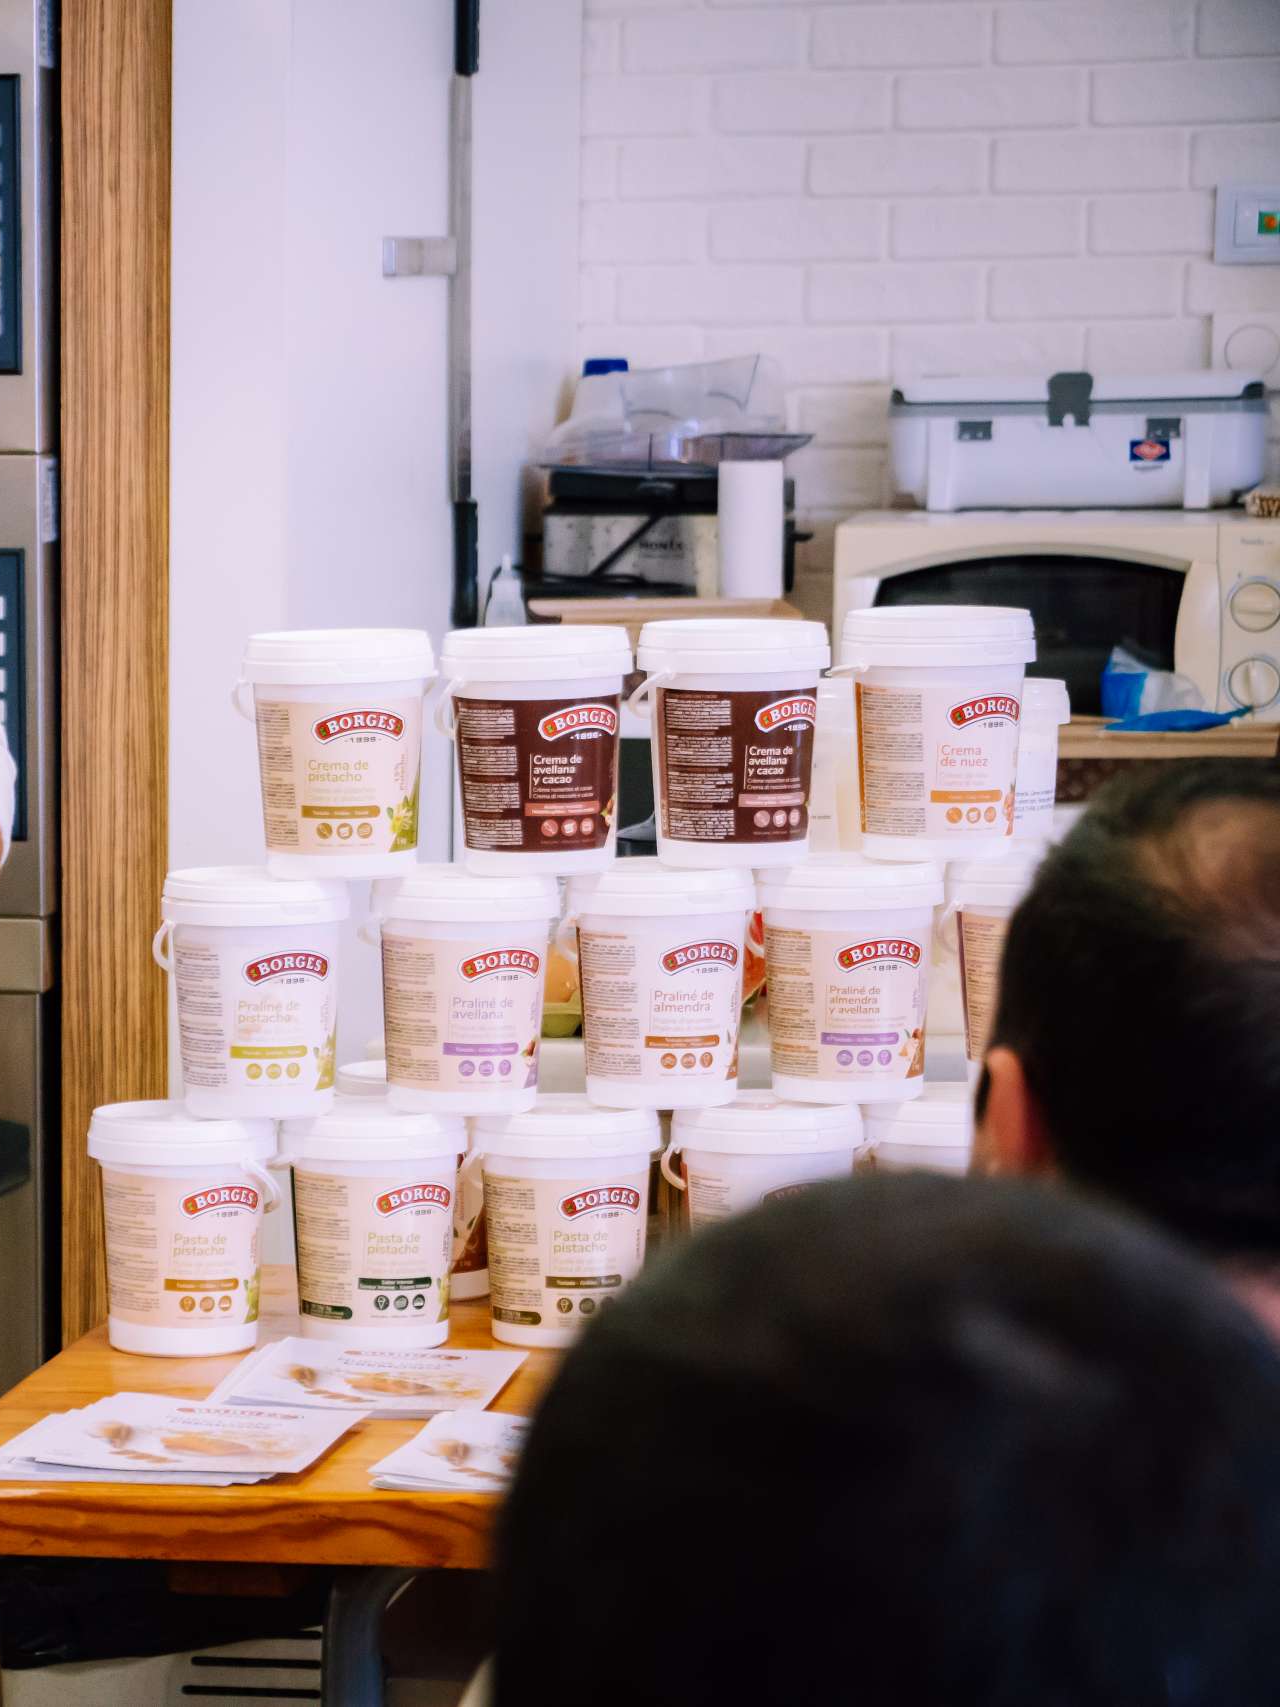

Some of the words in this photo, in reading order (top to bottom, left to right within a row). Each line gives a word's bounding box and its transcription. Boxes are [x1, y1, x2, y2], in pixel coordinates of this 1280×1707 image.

[963, 699, 1017, 719] BORGES
[326, 714, 396, 734] BORGES
[553, 710, 613, 731] BORGES
[749, 746, 781, 756] Crema
[782, 745, 794, 755] de
[941, 744, 982, 756] Crema
[308, 759, 350, 771] Crema
[353, 759, 369, 771] de
[533, 755, 568, 765] Crema
[570, 754, 583, 764] de
[749, 756, 788, 766] avellana
[940, 757, 957, 767] de
[960, 758, 989, 767] nuez
[533, 765, 577, 775] avellana
[748, 767, 755, 776] y
[756, 766, 785, 775] cacao
[308, 772, 362, 784] pistacho
[533, 776, 540, 786] y
[542, 775, 573, 784] cacao
[674, 945, 734, 965] BORGES
[849, 943, 916, 962] BORGES
[257, 955, 323, 976] BORGES
[473, 952, 536, 972] BORGES
[654, 990, 698, 1001] Praliné
[703, 990, 715, 1000] de
[829, 985, 866, 995] Praliné
[868, 986, 881, 995] de
[287, 1000, 300, 1011] de
[452, 997, 496, 1009] Praliné
[500, 998, 514, 1008] de
[829, 996, 879, 1005] almendra
[654, 1002, 711, 1013] almendra
[828, 1007, 835, 1015] y
[838, 1006, 880, 1014] avellana
[238, 1013, 292, 1024] pistacho
[452, 1010, 504, 1021] avellana
[194, 1189, 254, 1208] BORGES
[388, 1187, 447, 1207] BORGES
[573, 1190, 635, 1210] BORGES
[174, 1233, 208, 1245] Pasta
[213, 1233, 227, 1245] de
[367, 1232, 401, 1243] Pasta
[406, 1232, 420, 1243] de
[553, 1231, 589, 1242] Pasta
[593, 1231, 608, 1241] de
[173, 1246, 226, 1257] pistacho
[367, 1244, 419, 1255] pistacho
[553, 1243, 607, 1254] pistacho
